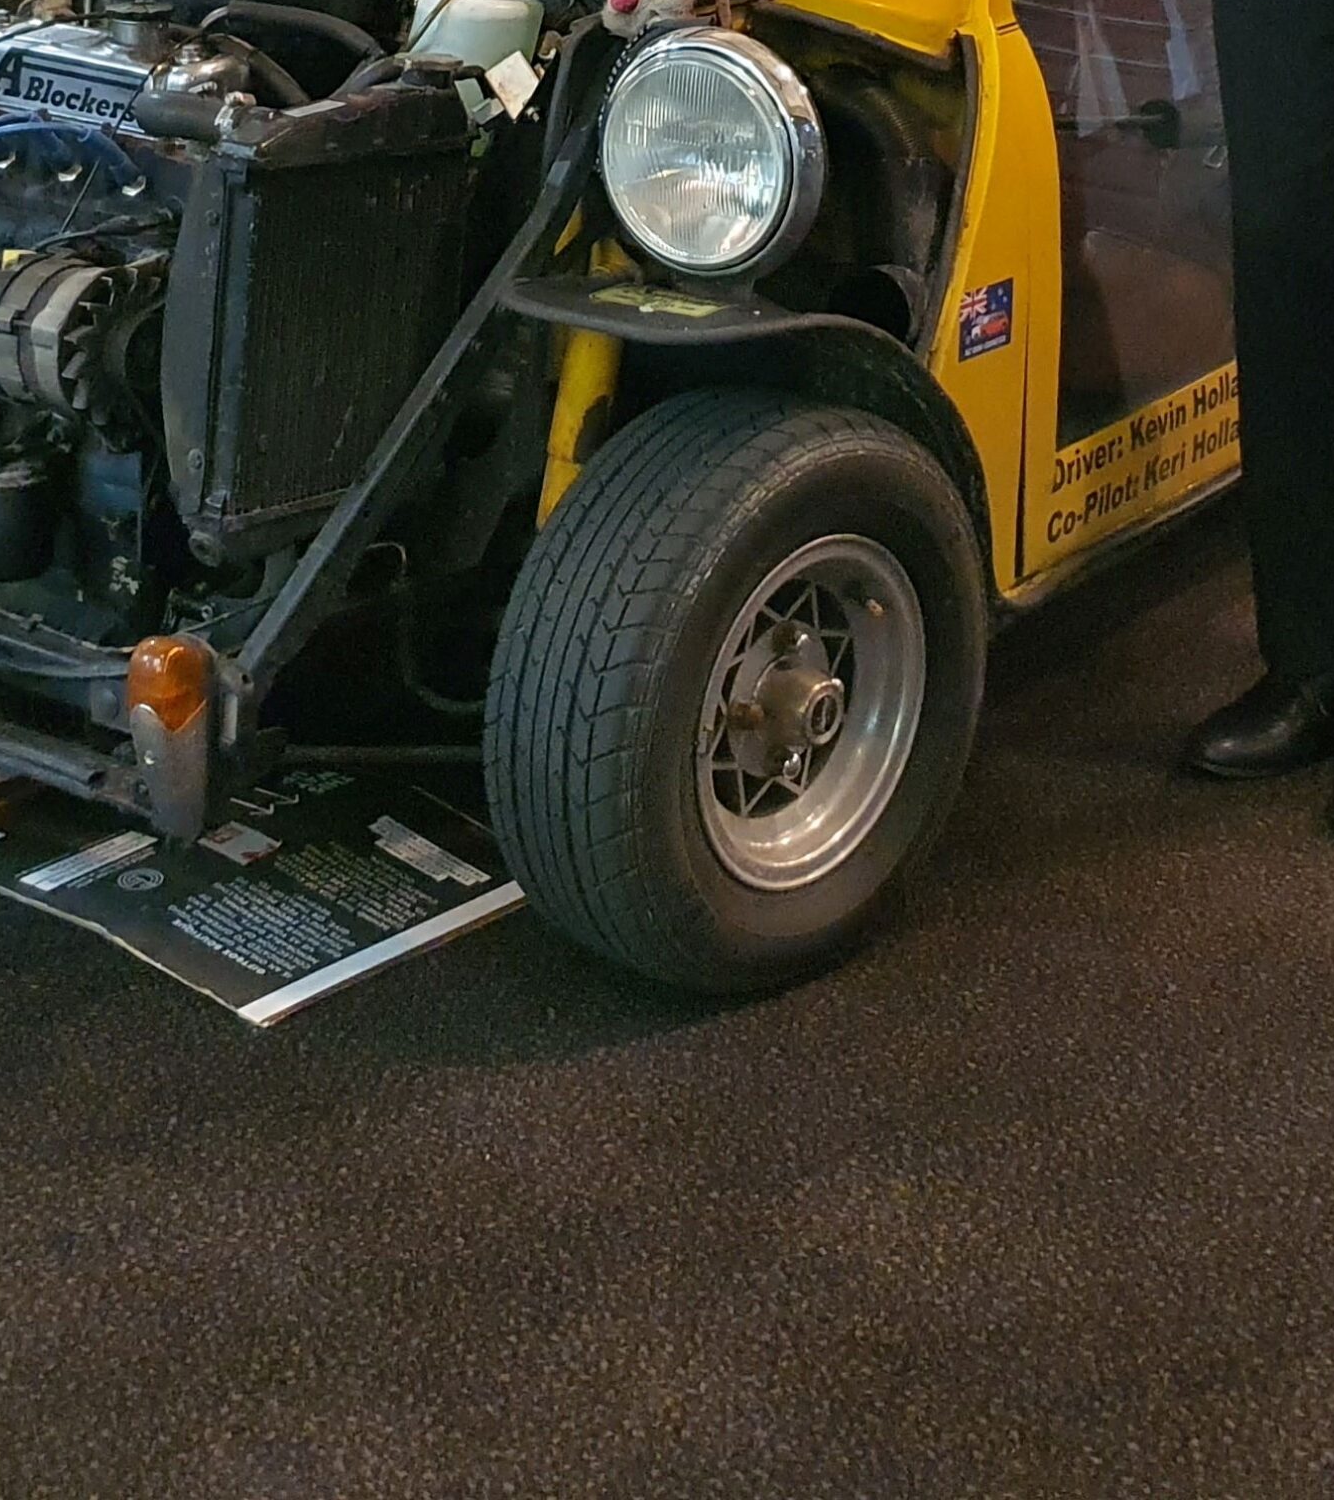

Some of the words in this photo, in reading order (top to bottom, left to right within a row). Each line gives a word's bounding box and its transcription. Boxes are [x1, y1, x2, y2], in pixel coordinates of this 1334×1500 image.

[23, 77, 138, 122] Blockers
[1047, 472, 1140, 544] Co-Pilot:
[1143, 442, 1186, 491] Keri
[1052, 435, 1123, 494] Driver:
[1129, 402, 1187, 451] Kevin
